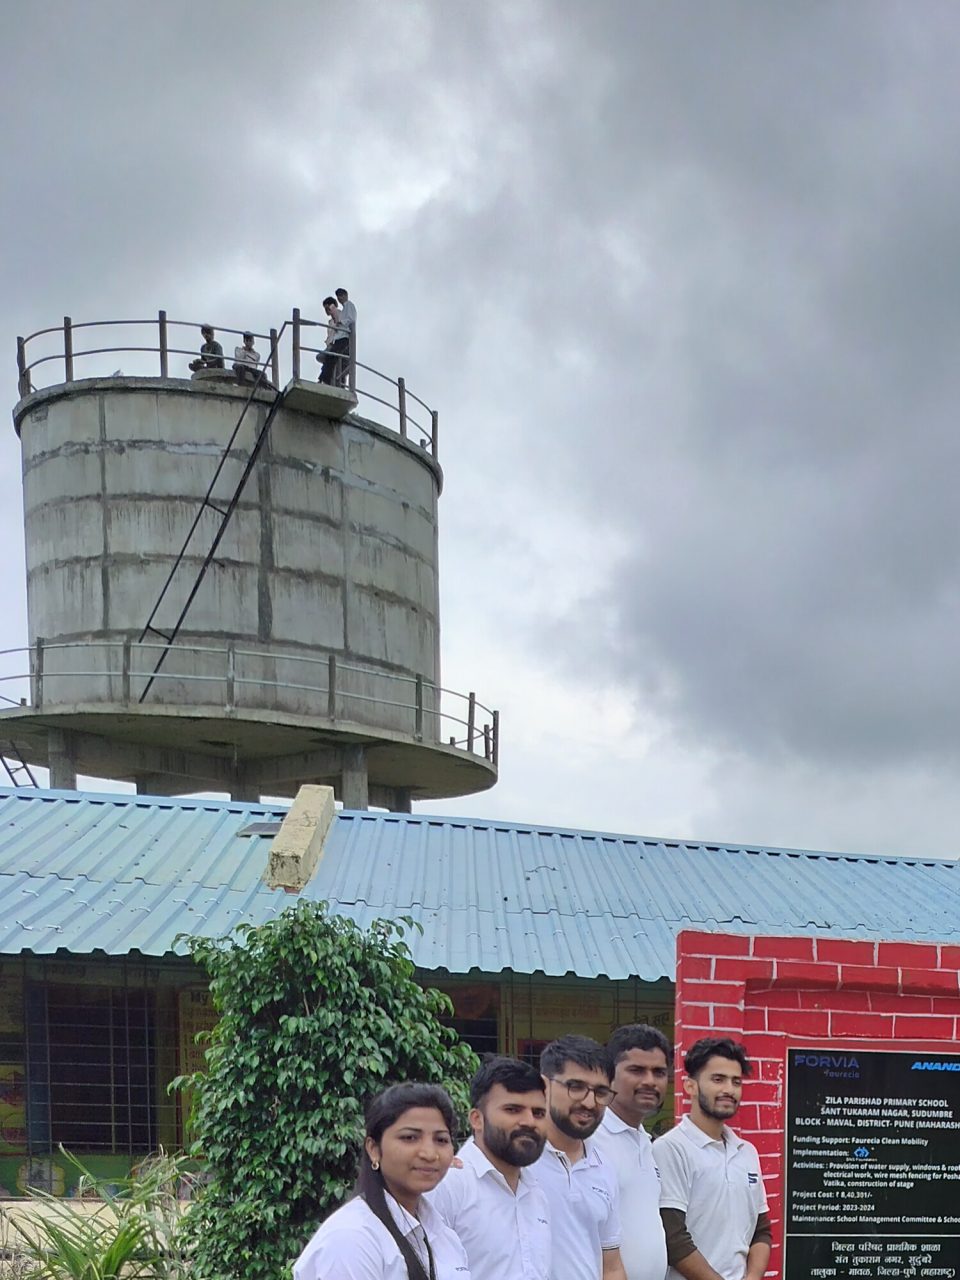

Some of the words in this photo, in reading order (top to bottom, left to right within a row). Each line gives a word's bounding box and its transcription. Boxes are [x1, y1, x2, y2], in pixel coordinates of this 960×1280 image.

[794, 1054, 859, 1069] FORVIA
[825, 1097, 842, 1105] ZILA
[844, 1097, 881, 1106] PARISHAD
[883, 1098, 917, 1107] PRIMARY
[919, 1099, 948, 1108] SCHOOL
[821, 1107, 841, 1116] SANT
[842, 1108, 880, 1117] TUKARAM
[881, 1109, 910, 1118] NAGAR,
[912, 1110, 953, 1119] SUDUMBRE
[795, 1118, 821, 1126] BLOCK
[827, 1119, 855, 1128] MAVAL,
[857, 1119, 893, 1128] DISTRICT-
[894, 1120, 914, 1129] PUNE
[793, 1136, 820, 1145] Funding
[821, 1136, 851, 1145] Support:
[852, 1137, 880, 1145] Faurecia
[881, 1137, 900, 1145] Clean
[901, 1138, 929, 1147] Mobility
[793, 1149, 849, 1157] Implementation:
[793, 1162, 825, 1170] Activities:
[829, 1162, 859, 1170] Provision
[888, 1164, 911, 1173] supply,
[912, 1164, 940, 1172] windows
[941, 1164, 947, 1172] &
[948, 1164, 960, 1172] roof
[855, 1172, 872, 1180] work,
[889, 1171, 907, 1179] mesh
[908, 1172, 931, 1181] fencing
[823, 1180, 846, 1188] Vatika,
[847, 1180, 888, 1188] construction
[889, 1180, 896, 1188] of
[897, 1181, 914, 1190] stage
[793, 1191, 816, 1200] Project
[818, 1191, 834, 1199] Cost:
[793, 1204, 816, 1213] Project
[818, 1204, 841, 1212] Period:
[842, 1204, 875, 1212] 2023-2024
[792, 1215, 836, 1223] Maintenance:
[837, 1215, 858, 1223] School
[859, 1216, 900, 1225] Management
[832, 1241, 855, 1252] जिल्हा
[858, 1242, 883, 1252] परिषद
[886, 1241, 917, 1252] प्राथमिक
[920, 1243, 941, 1252] शाळा
[835, 1255, 848, 1264] संत
[852, 1256, 881, 1267] तुकाराम
[884, 1256, 904, 1265] नगर,
[811, 1268, 837, 1279] तालुका
[848, 1268, 873, 1277] मावळ,
